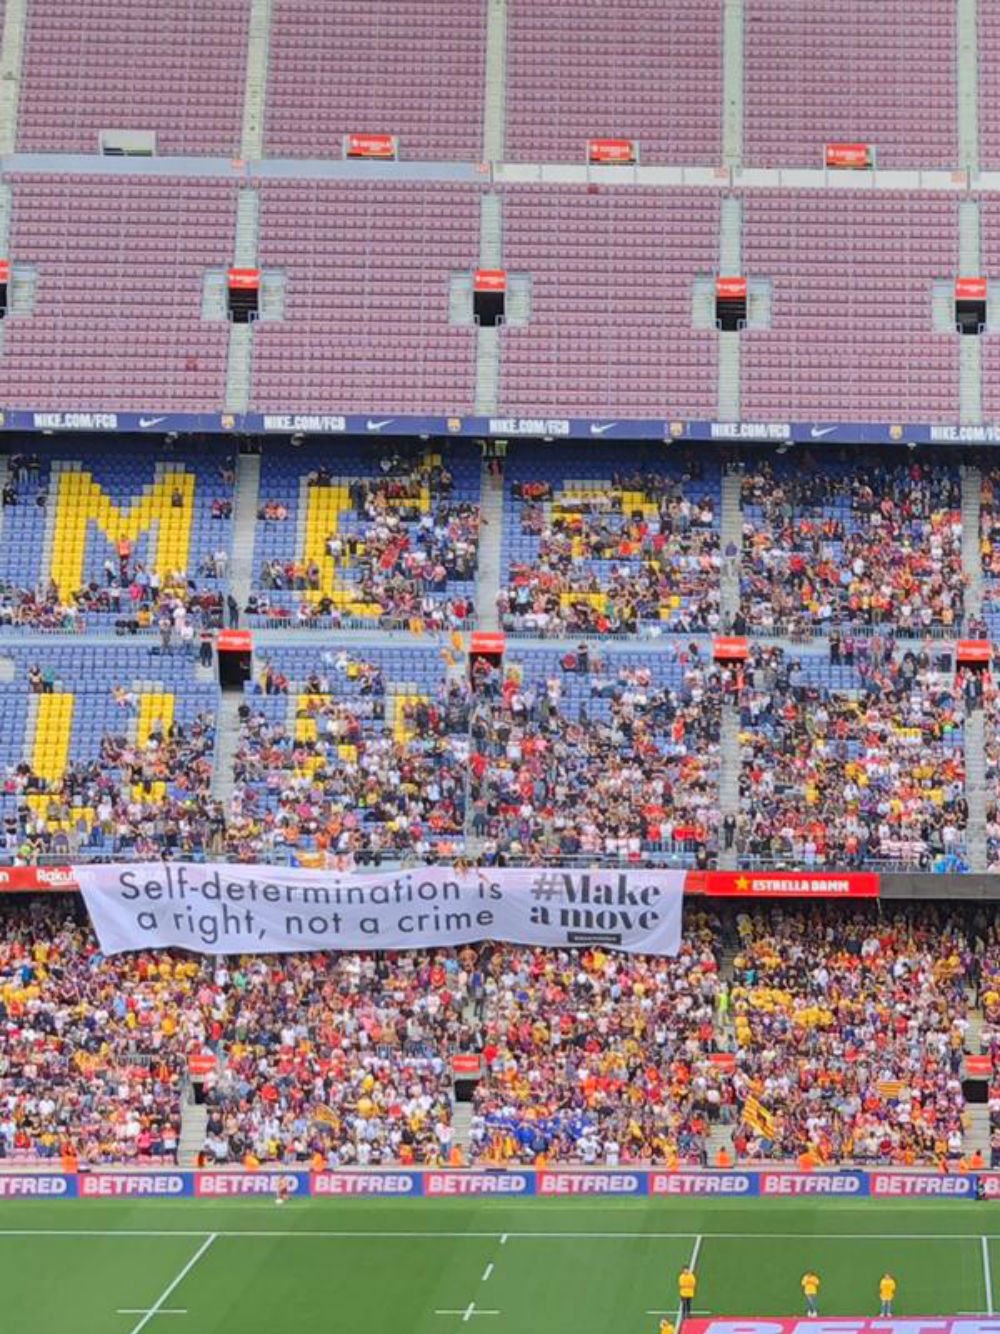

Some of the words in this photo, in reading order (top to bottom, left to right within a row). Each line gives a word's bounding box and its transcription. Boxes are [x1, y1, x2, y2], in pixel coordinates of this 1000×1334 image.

[33, 413, 118, 429] NIKE.COM/FCB
[264, 416, 346, 431] NIKE.COM/FCB
[489, 418, 570, 434] NIKE.COM/FCB
[711, 422, 791, 438] NIKE.COM/FCB
[119, 866, 460, 904] Self-determination
[478, 879, 503, 900] is
[530, 873, 661, 906] #Make
[752, 879, 809, 892] ESTRELLA
[811, 880, 849, 892] DAMM
[137, 911, 158, 931] a
[173, 904, 266, 944] right,
[286, 910, 341, 935] not
[359, 915, 379, 935] a
[397, 905, 494, 934] crime
[530, 906, 551, 924] a
[561, 908, 660, 930] move
[83, 1177, 183, 1193] BETFRED
[314, 1176, 413, 1192] BETFRED
[428, 1176, 526, 1192] BETFRED
[540, 1176, 637, 1191] BETFRED
[653, 1176, 749, 1192] BETFRED
[765, 1176, 860, 1193] BETFRED
[875, 1176, 969, 1194] BETFRED
